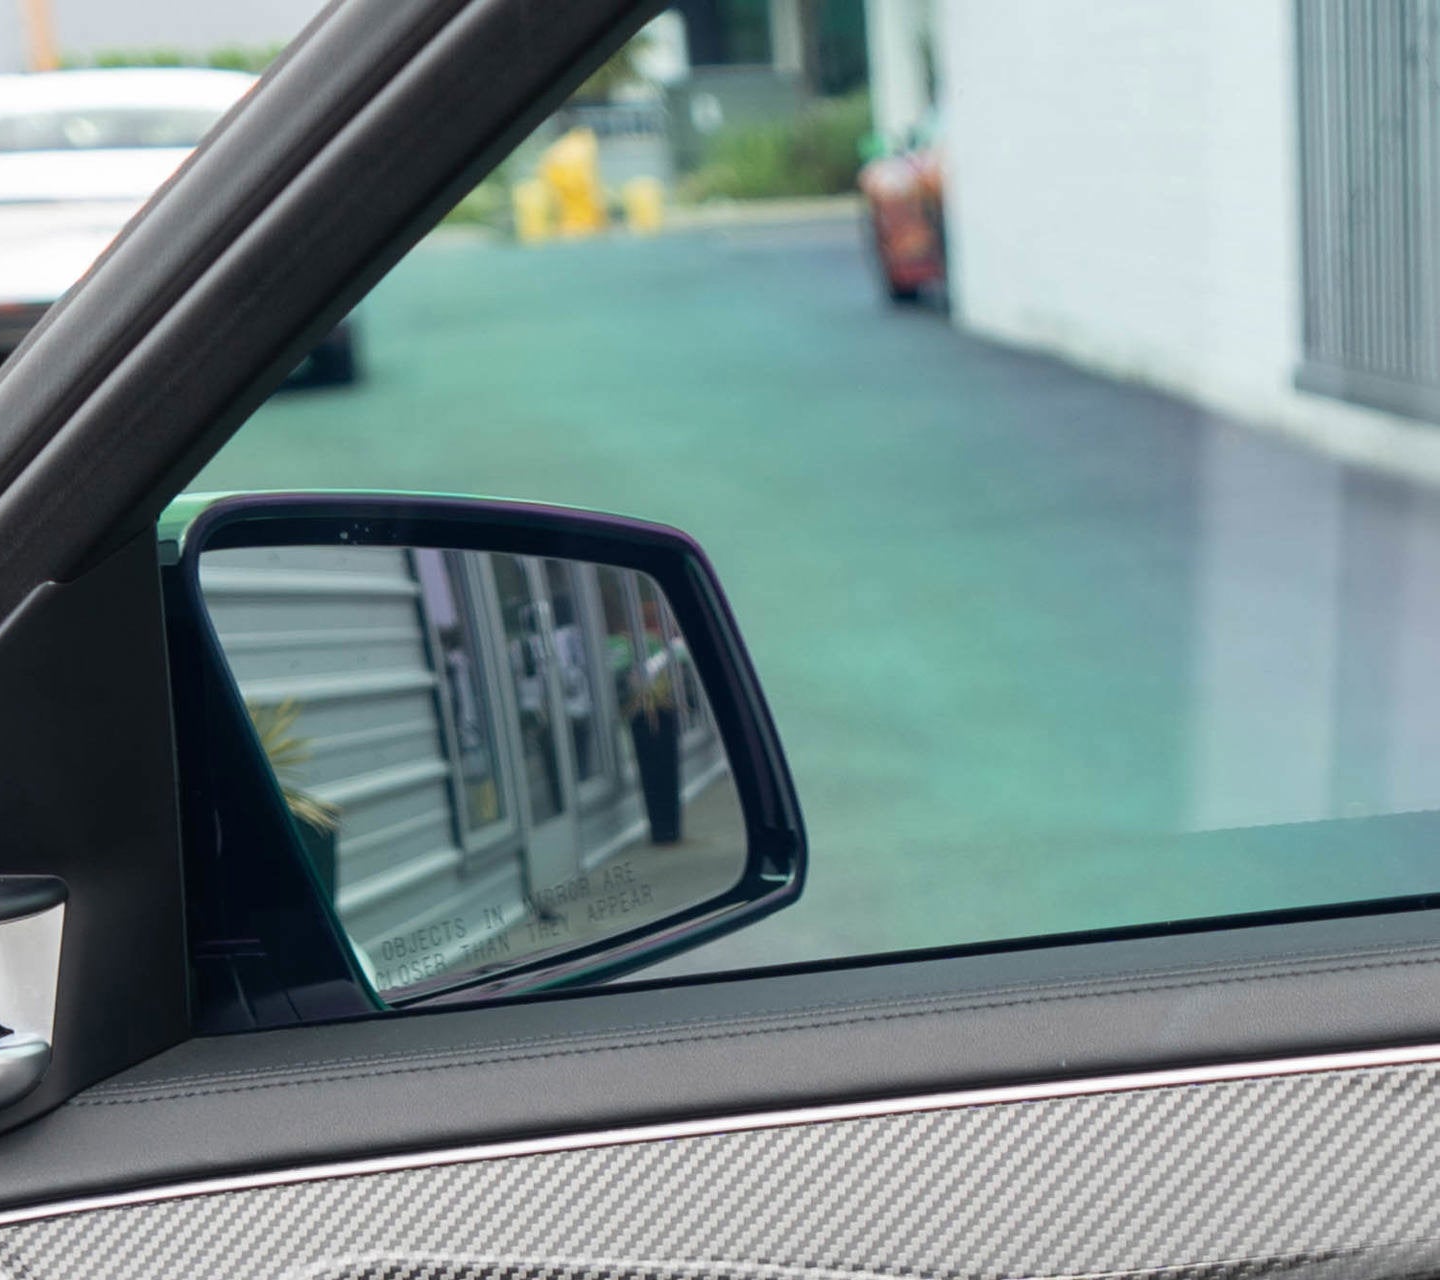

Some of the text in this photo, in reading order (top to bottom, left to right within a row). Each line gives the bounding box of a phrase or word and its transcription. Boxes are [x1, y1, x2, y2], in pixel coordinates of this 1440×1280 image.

[381, 917, 467, 961] OBJECTS
[482, 904, 509, 930] IN
[603, 861, 637, 893] ARE
[460, 930, 511, 963] THAN
[588, 883, 657, 923] APPEAR
